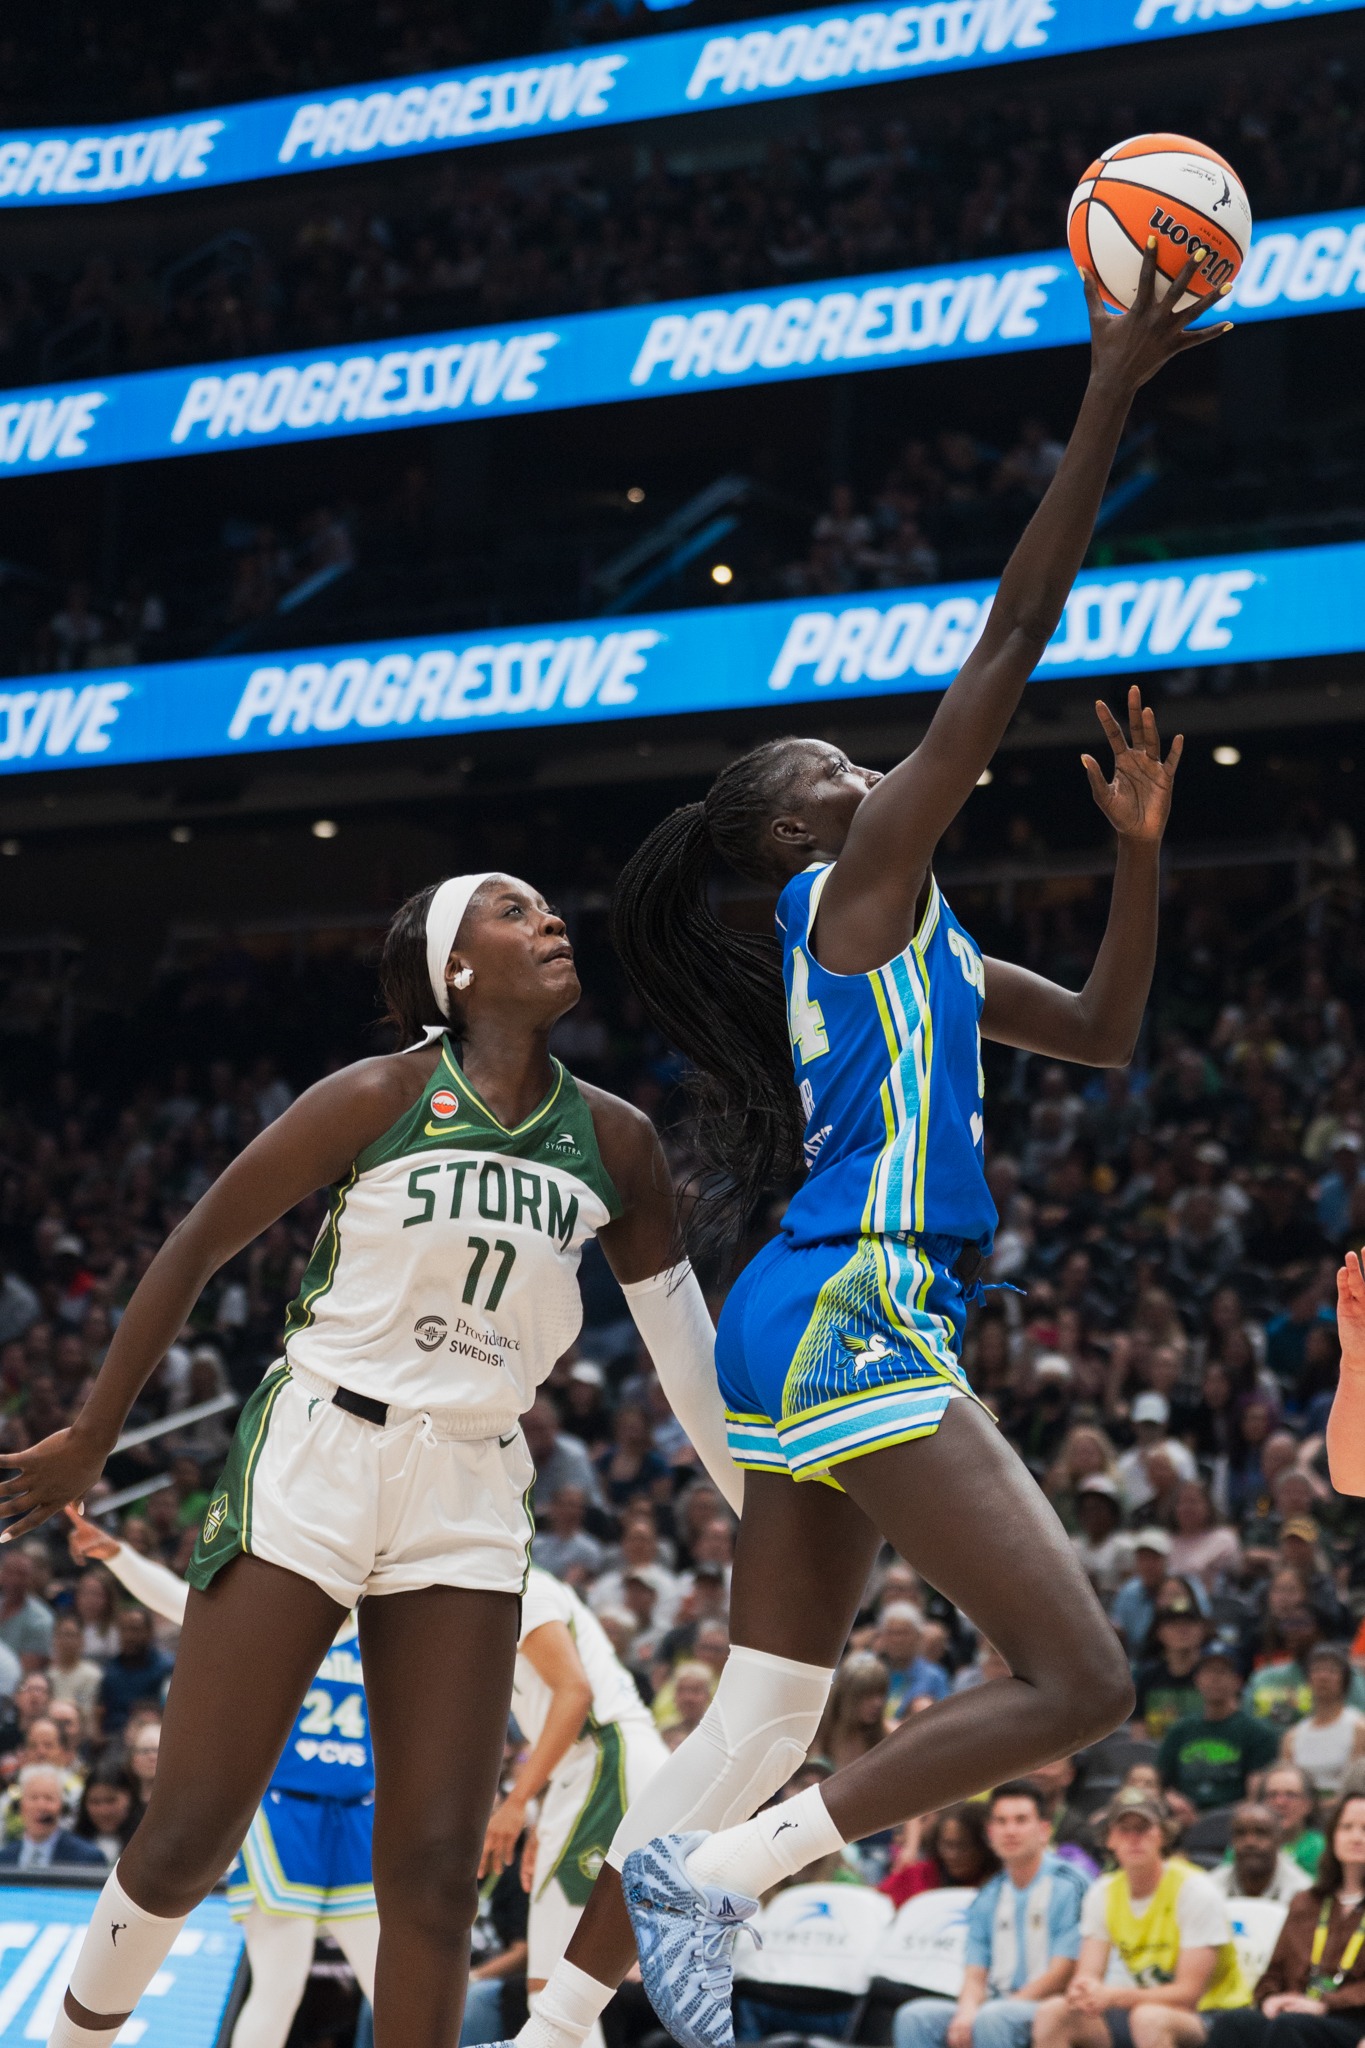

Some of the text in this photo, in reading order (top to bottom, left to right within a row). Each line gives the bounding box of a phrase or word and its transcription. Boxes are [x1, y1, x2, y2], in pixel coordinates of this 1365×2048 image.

[278, 54, 628, 163] PROGRESSIVE
[171, 332, 559, 443] PROGRESSIVE
[630, 265, 1061, 386] PROGRESSIVE
[228, 629, 662, 739] PROGRESSIVE
[768, 570, 1258, 690] PROGSSIVE
[545, 1141, 582, 1156] SYMETRA
[402, 1160, 579, 1253] STORM
[461, 1235, 517, 1312] 11
[449, 1340, 506, 1368] SWEDISH
[455, 1318, 521, 1351] Providence
[299, 1688, 366, 1739] 24
[317, 1739, 367, 1767] CVS
